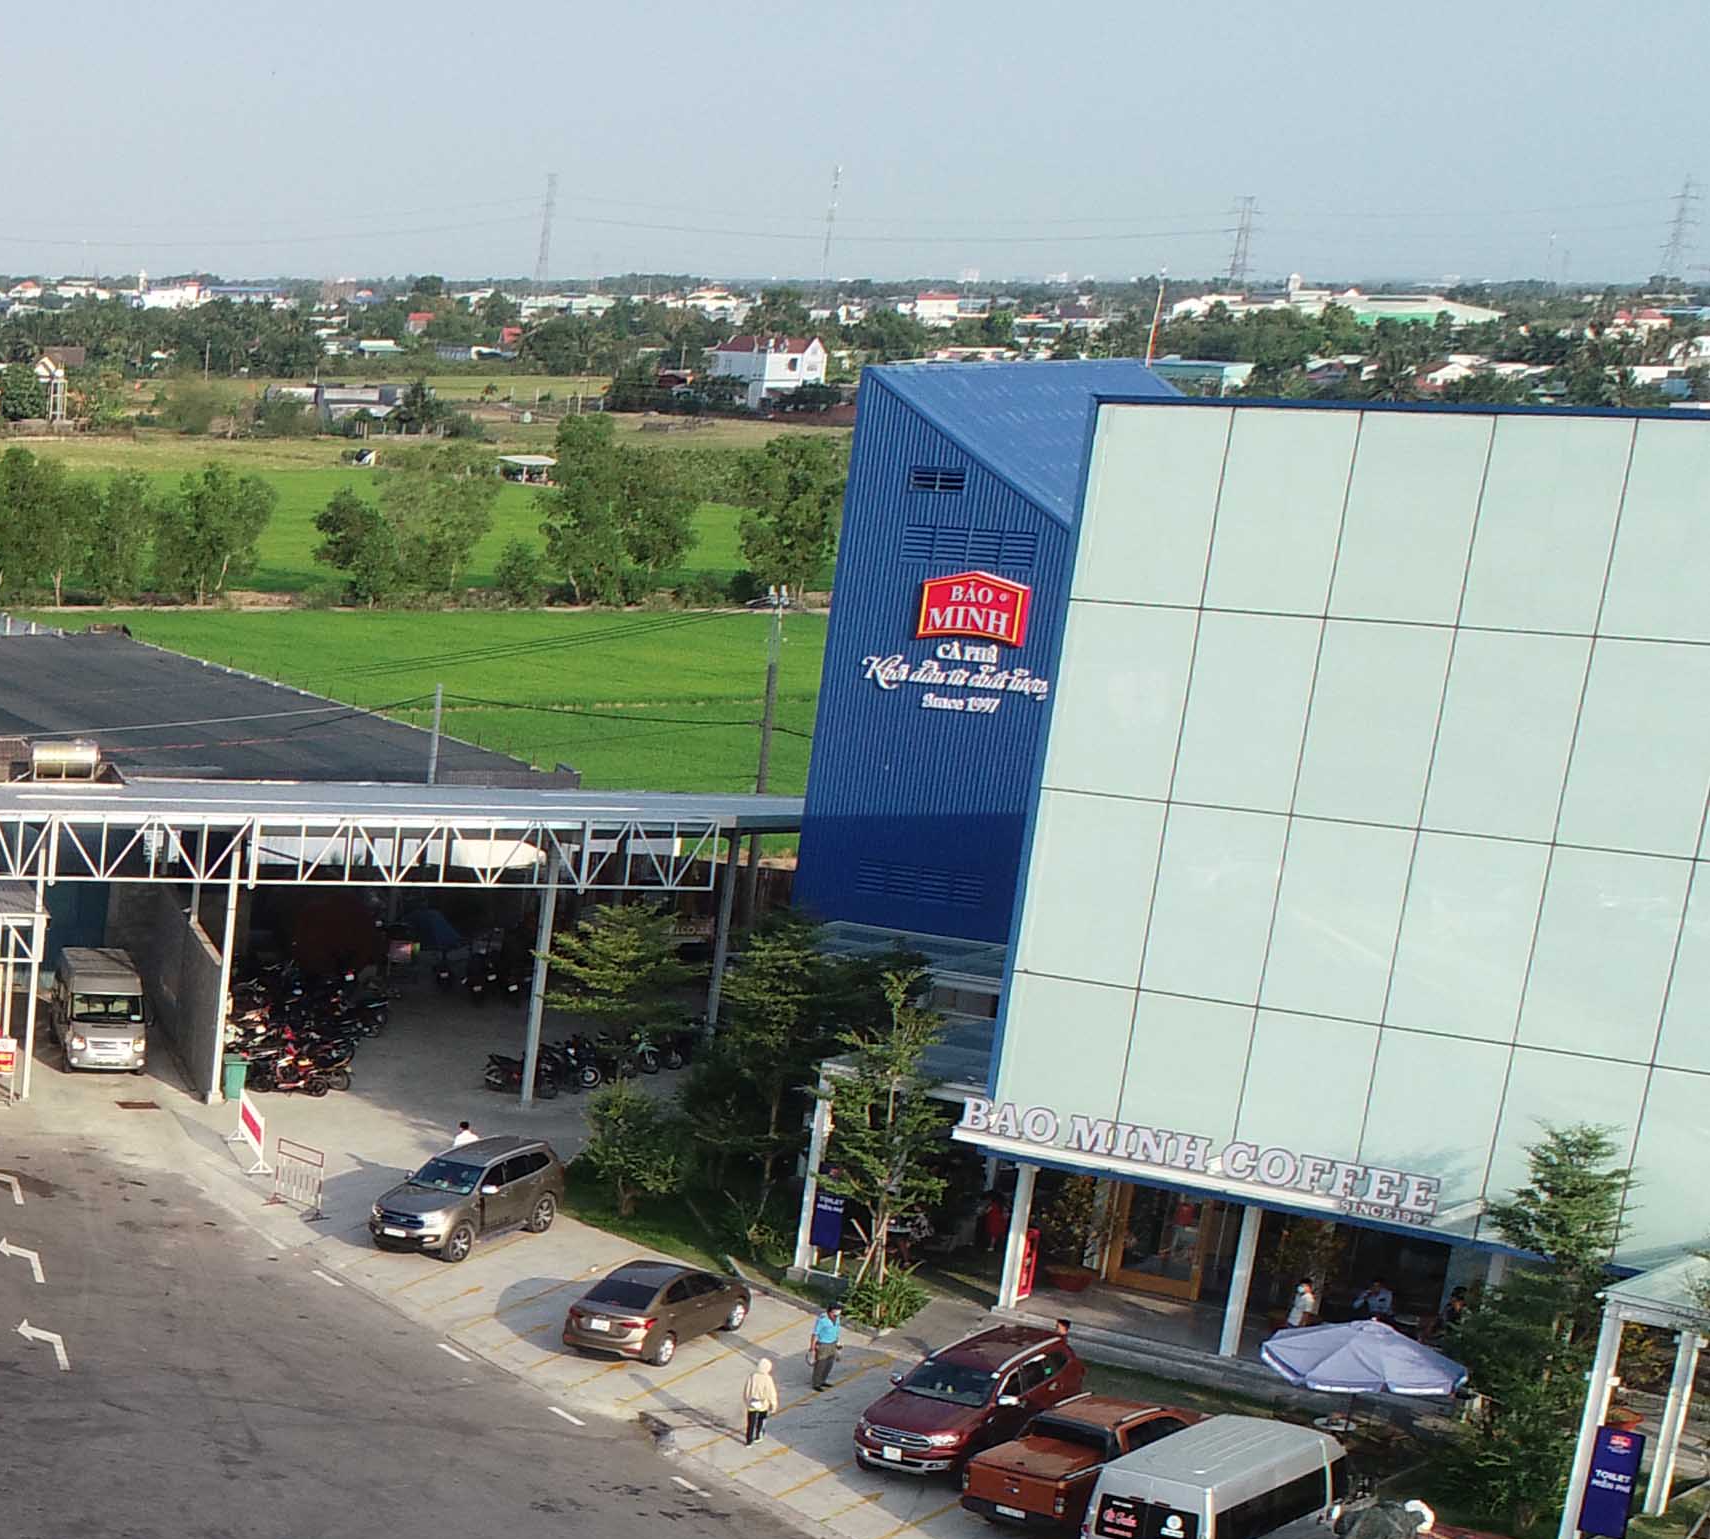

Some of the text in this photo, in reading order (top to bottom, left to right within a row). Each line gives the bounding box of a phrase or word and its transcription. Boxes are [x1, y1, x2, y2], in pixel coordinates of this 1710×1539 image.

[950, 581, 994, 604] BẢO
[927, 605, 1010, 637] MINH
[936, 641, 998, 664] CÀ PHÊ
[922, 692, 1001, 714] Since 1997
[957, 1096, 1441, 1216] BAO MINH COFFEE
